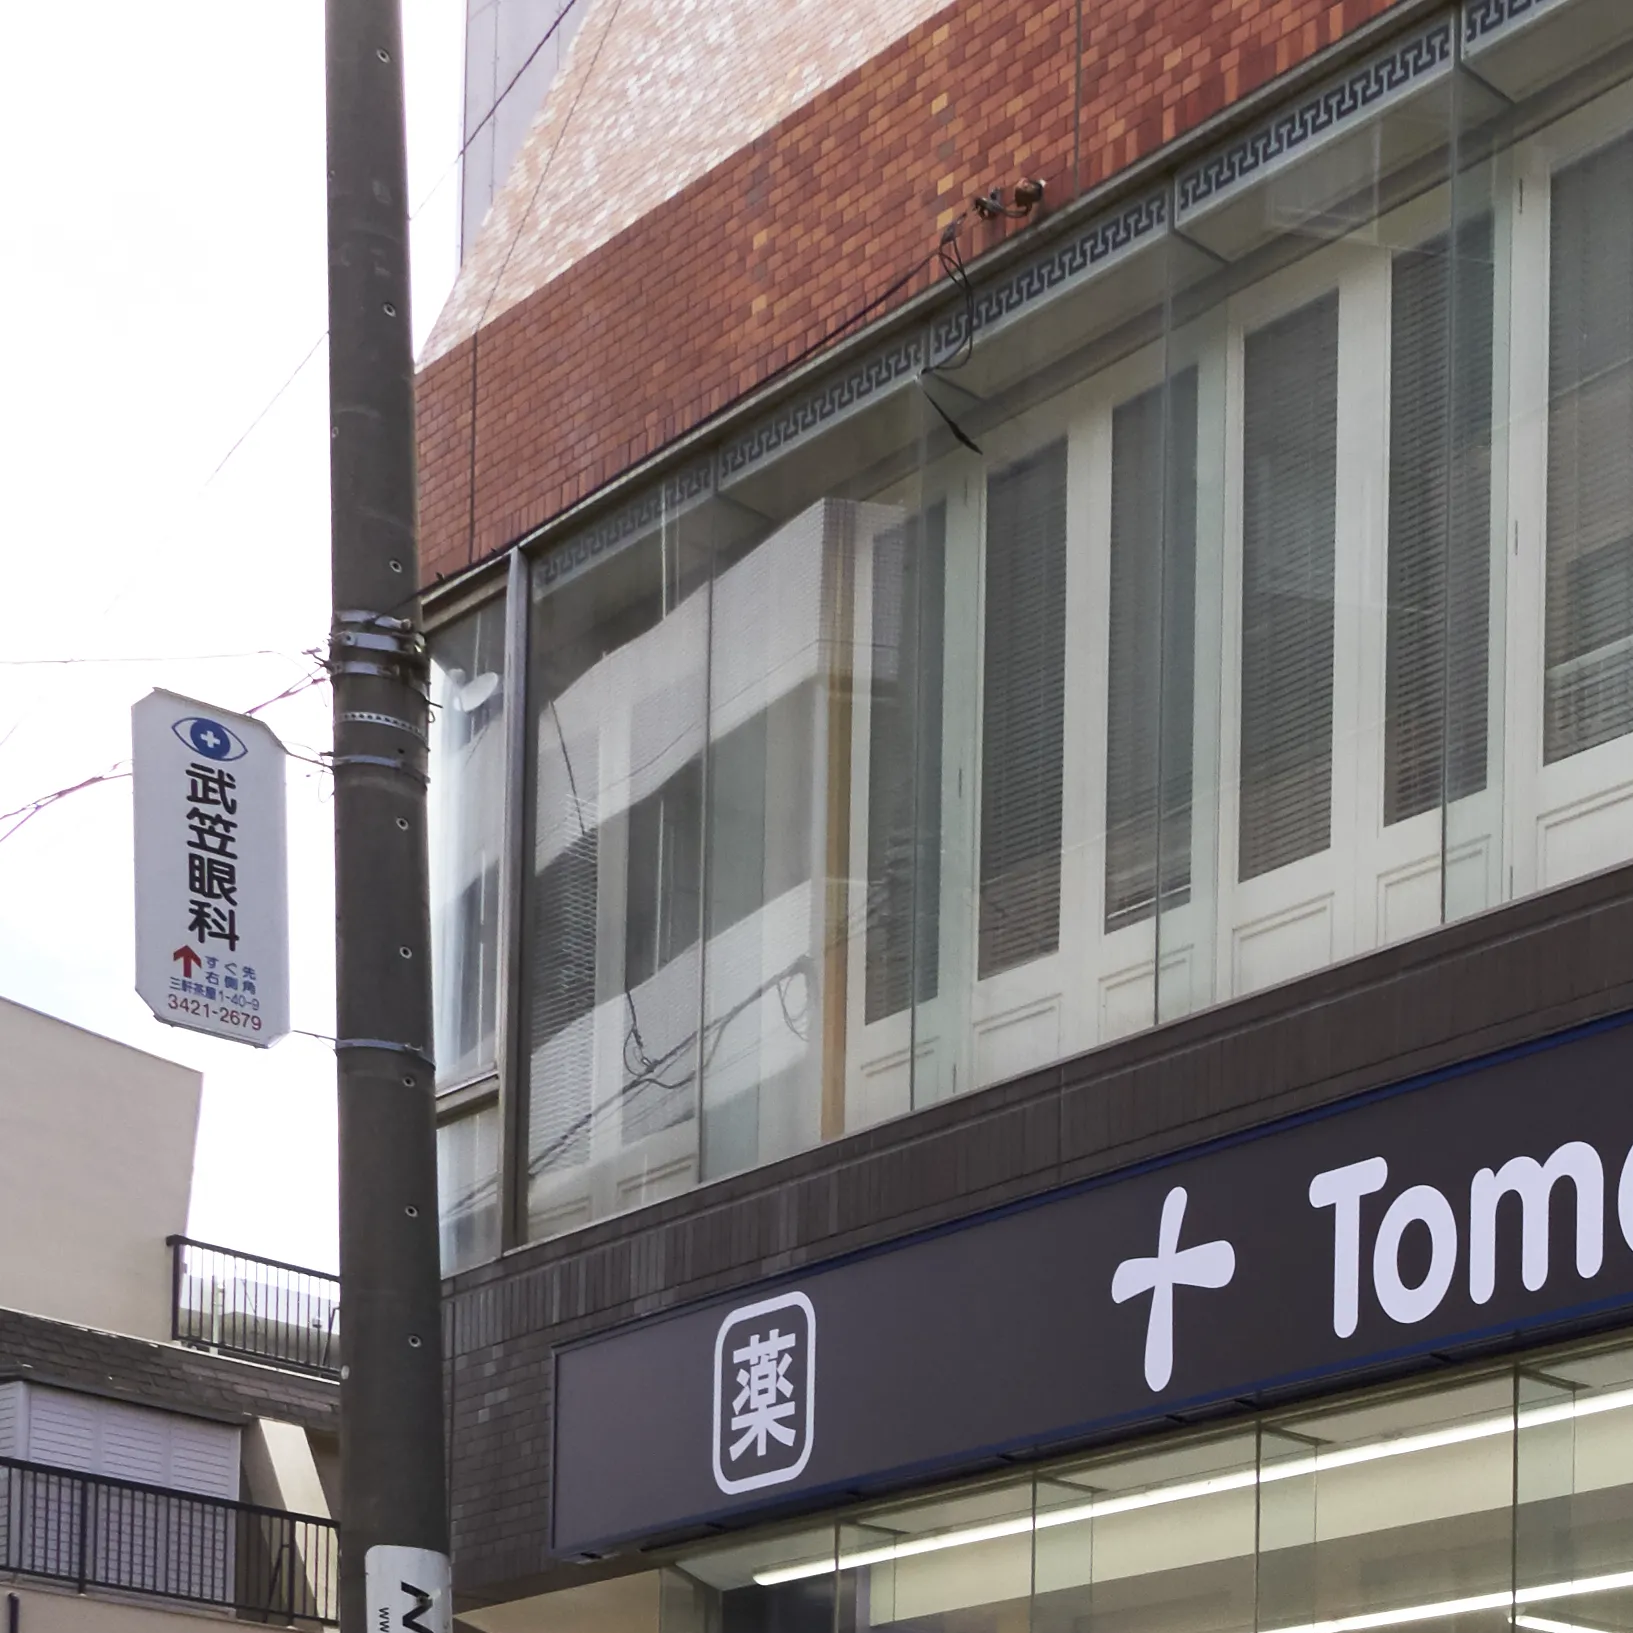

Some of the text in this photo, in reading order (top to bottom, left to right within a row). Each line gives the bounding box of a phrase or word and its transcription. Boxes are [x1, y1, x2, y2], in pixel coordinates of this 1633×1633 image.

[185, 762, 240, 952] 武笠眼科
[205, 955, 257, 981] すぐ先
[206, 971, 257, 996] 右側角
[168, 994, 262, 1031] 3421-2679
[729, 1328, 796, 1462] 薬
